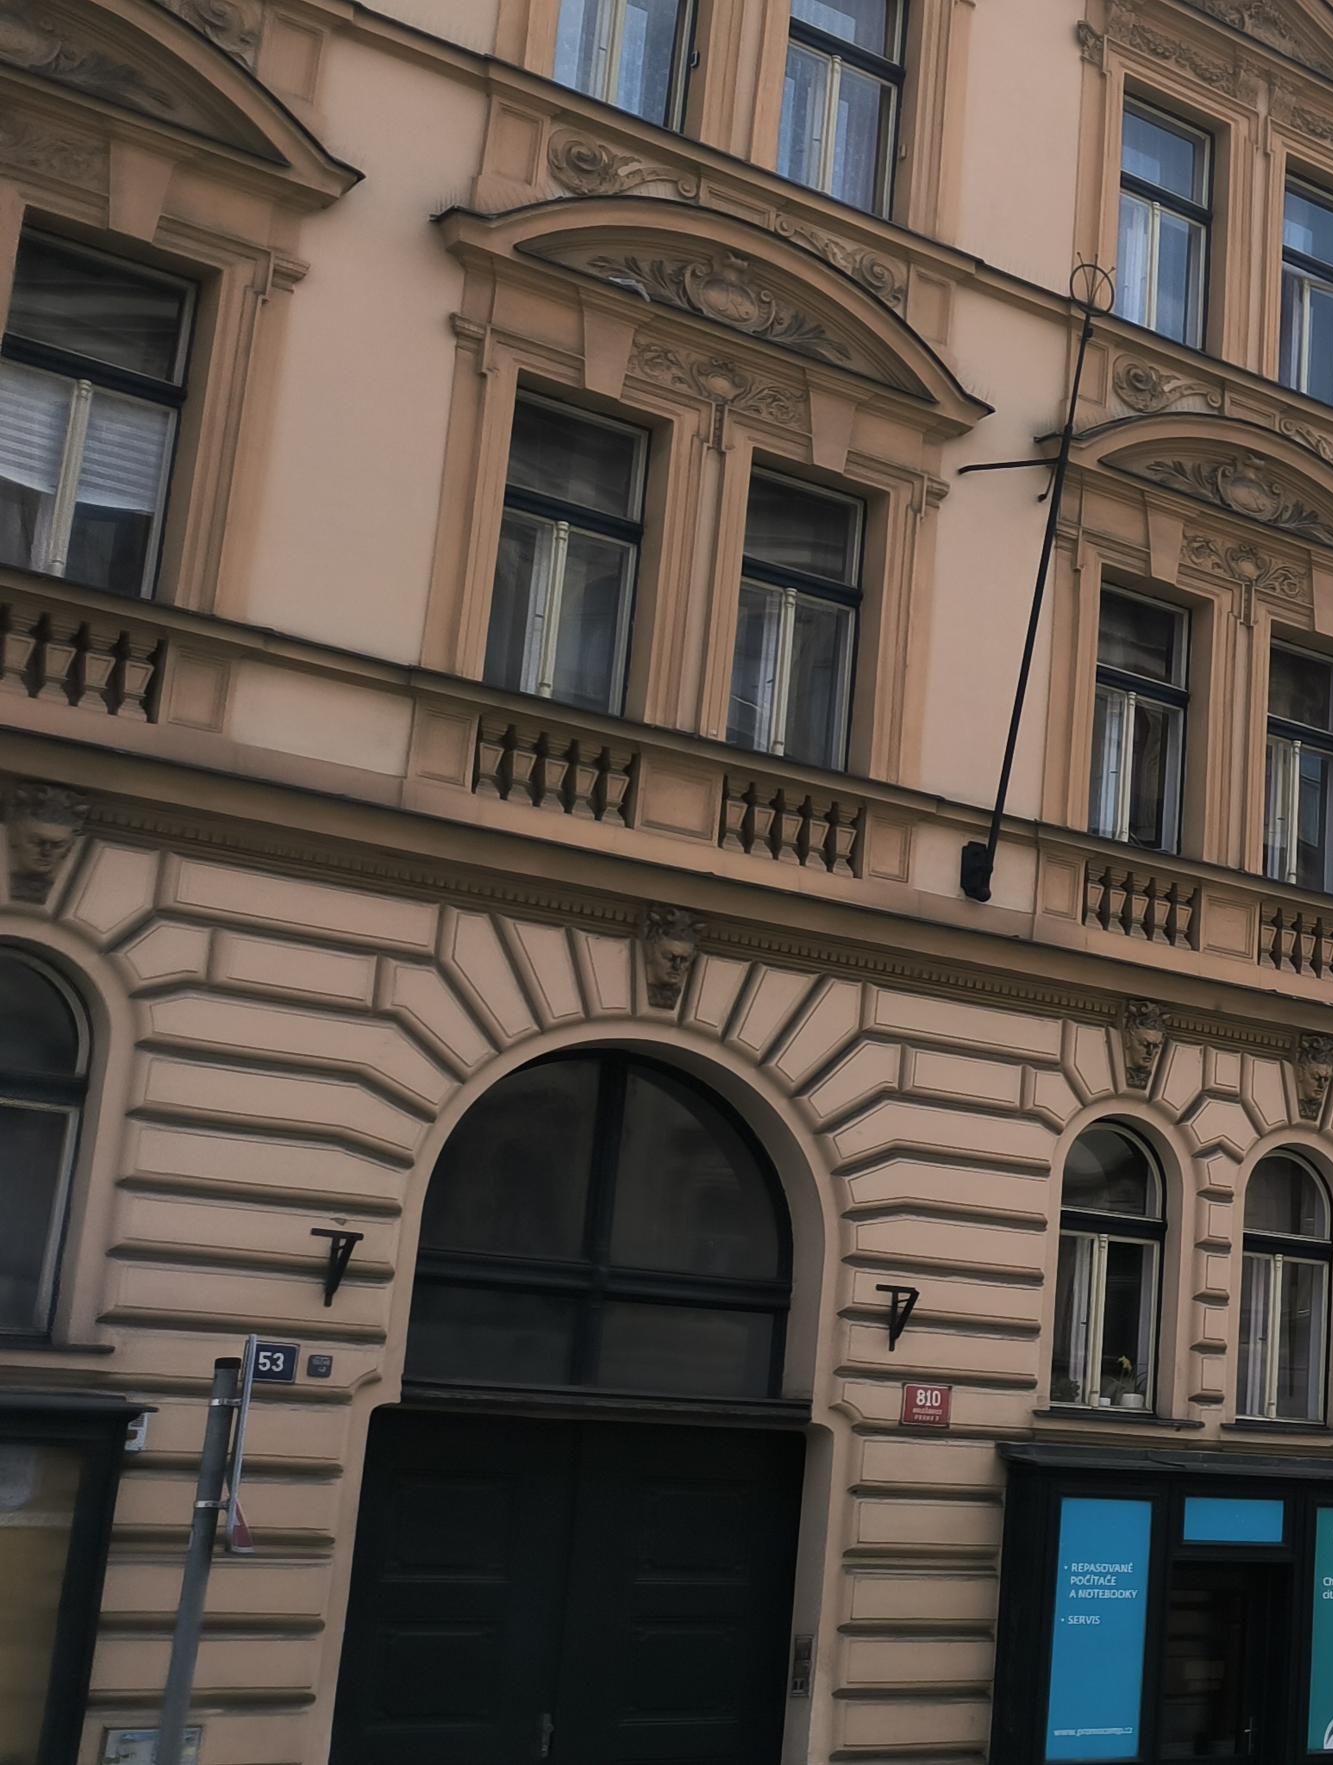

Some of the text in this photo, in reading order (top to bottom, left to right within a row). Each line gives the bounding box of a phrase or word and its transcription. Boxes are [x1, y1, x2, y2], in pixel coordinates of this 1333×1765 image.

[258, 1351, 284, 1372] 53
[916, 1389, 941, 1406] 810
[1071, 1562, 1133, 1573] REPASOVANÉ
[1070, 1575, 1117, 1586] POČÍTAČE
[1069, 1589, 1138, 1599] A NOTEBOOKY
[1067, 1615, 1101, 1625] SERVIS
